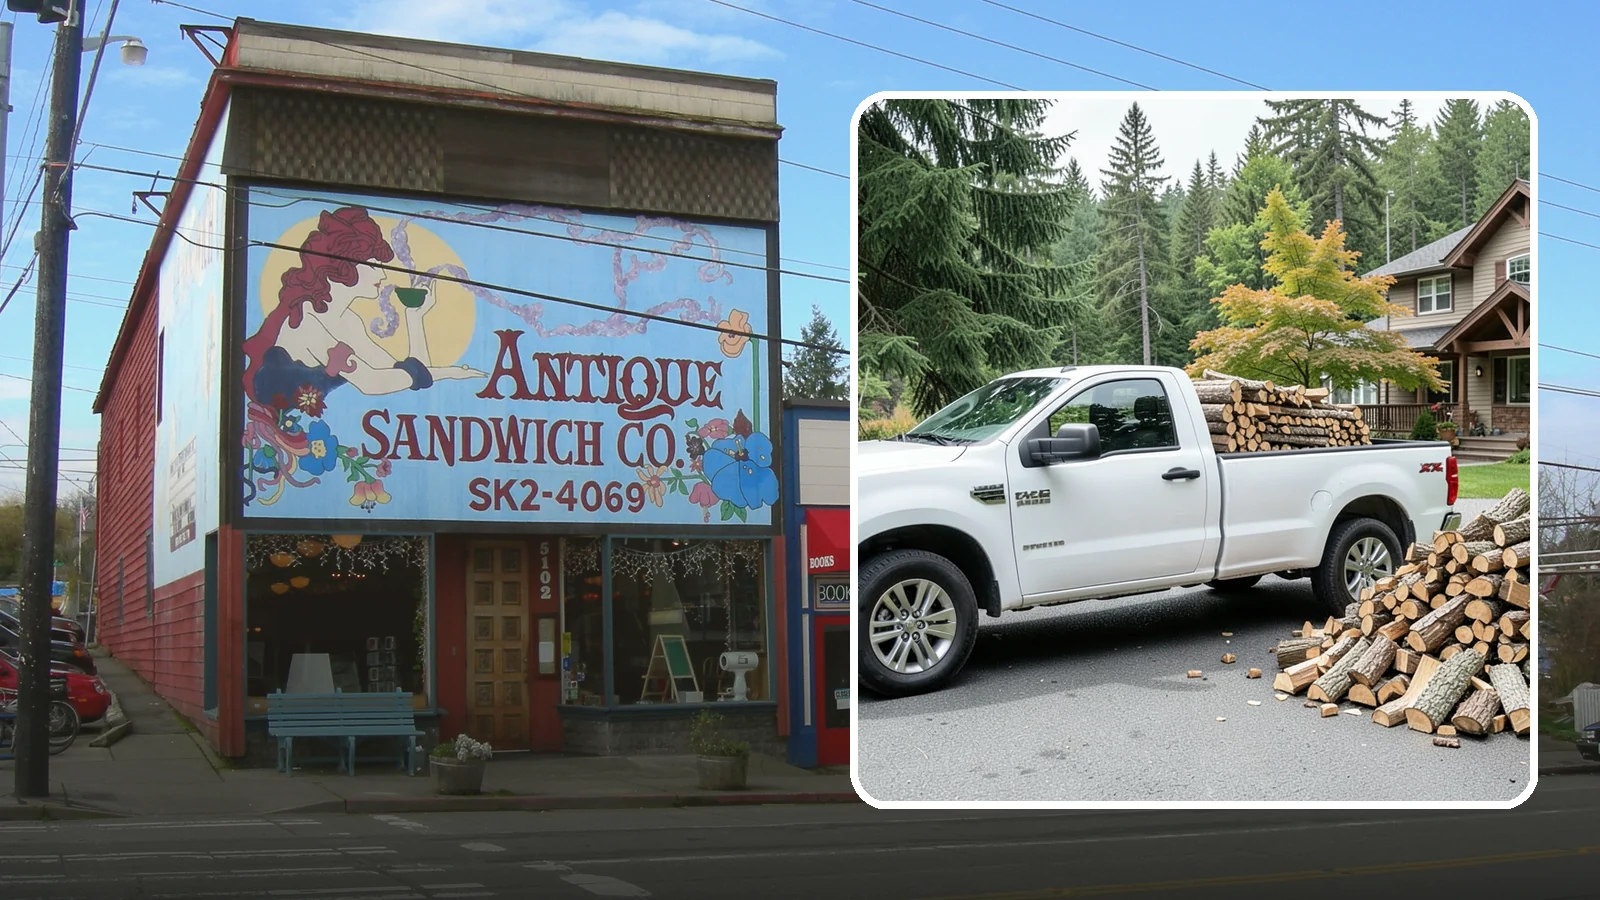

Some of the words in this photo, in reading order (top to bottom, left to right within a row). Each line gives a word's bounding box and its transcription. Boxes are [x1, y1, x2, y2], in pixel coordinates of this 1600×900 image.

[475, 329, 723, 421] ANTIQUE
[361, 409, 604, 467] SANDWICH
[617, 422, 685, 468] CO.
[468, 477, 645, 513] SK2-4069
[539, 542, 551, 600] 5102
[809, 555, 835, 569] BOOKS
